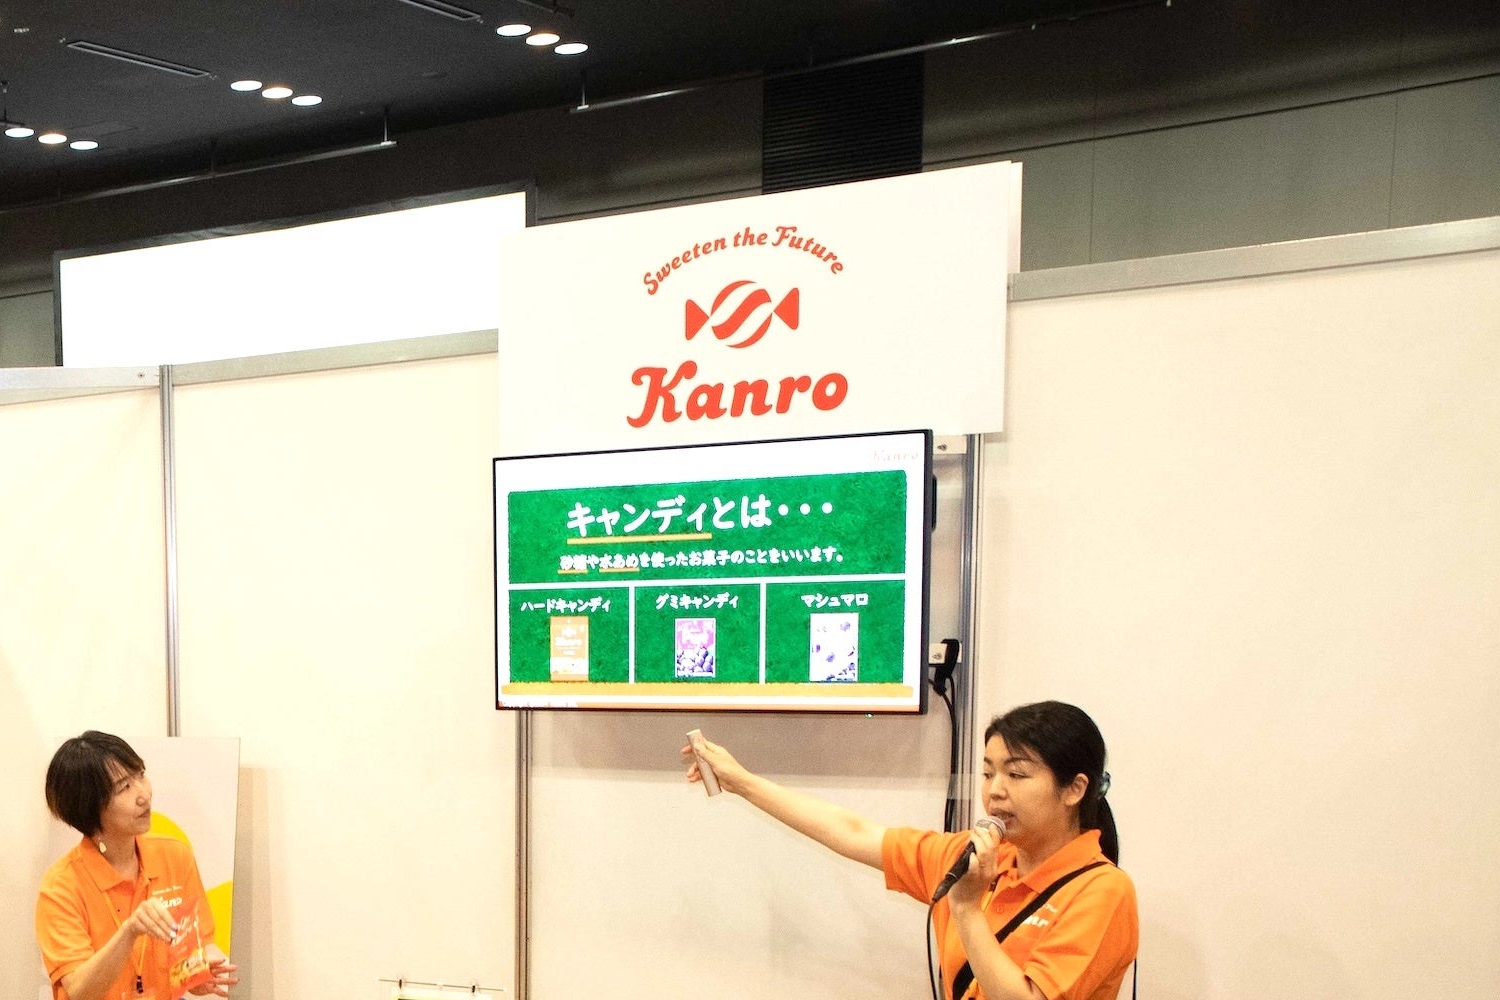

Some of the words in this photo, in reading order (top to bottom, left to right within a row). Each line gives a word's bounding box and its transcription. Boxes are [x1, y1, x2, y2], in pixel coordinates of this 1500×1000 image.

[643, 237, 728, 296] Sweeten
[733, 227, 769, 248] the
[772, 226, 844, 275] Future
[626, 360, 849, 428] Kanro
[520, 596, 612, 613] ハードキャンディ
[655, 592, 739, 610] グミキャンディ
[801, 593, 869, 608] マシュマロ
